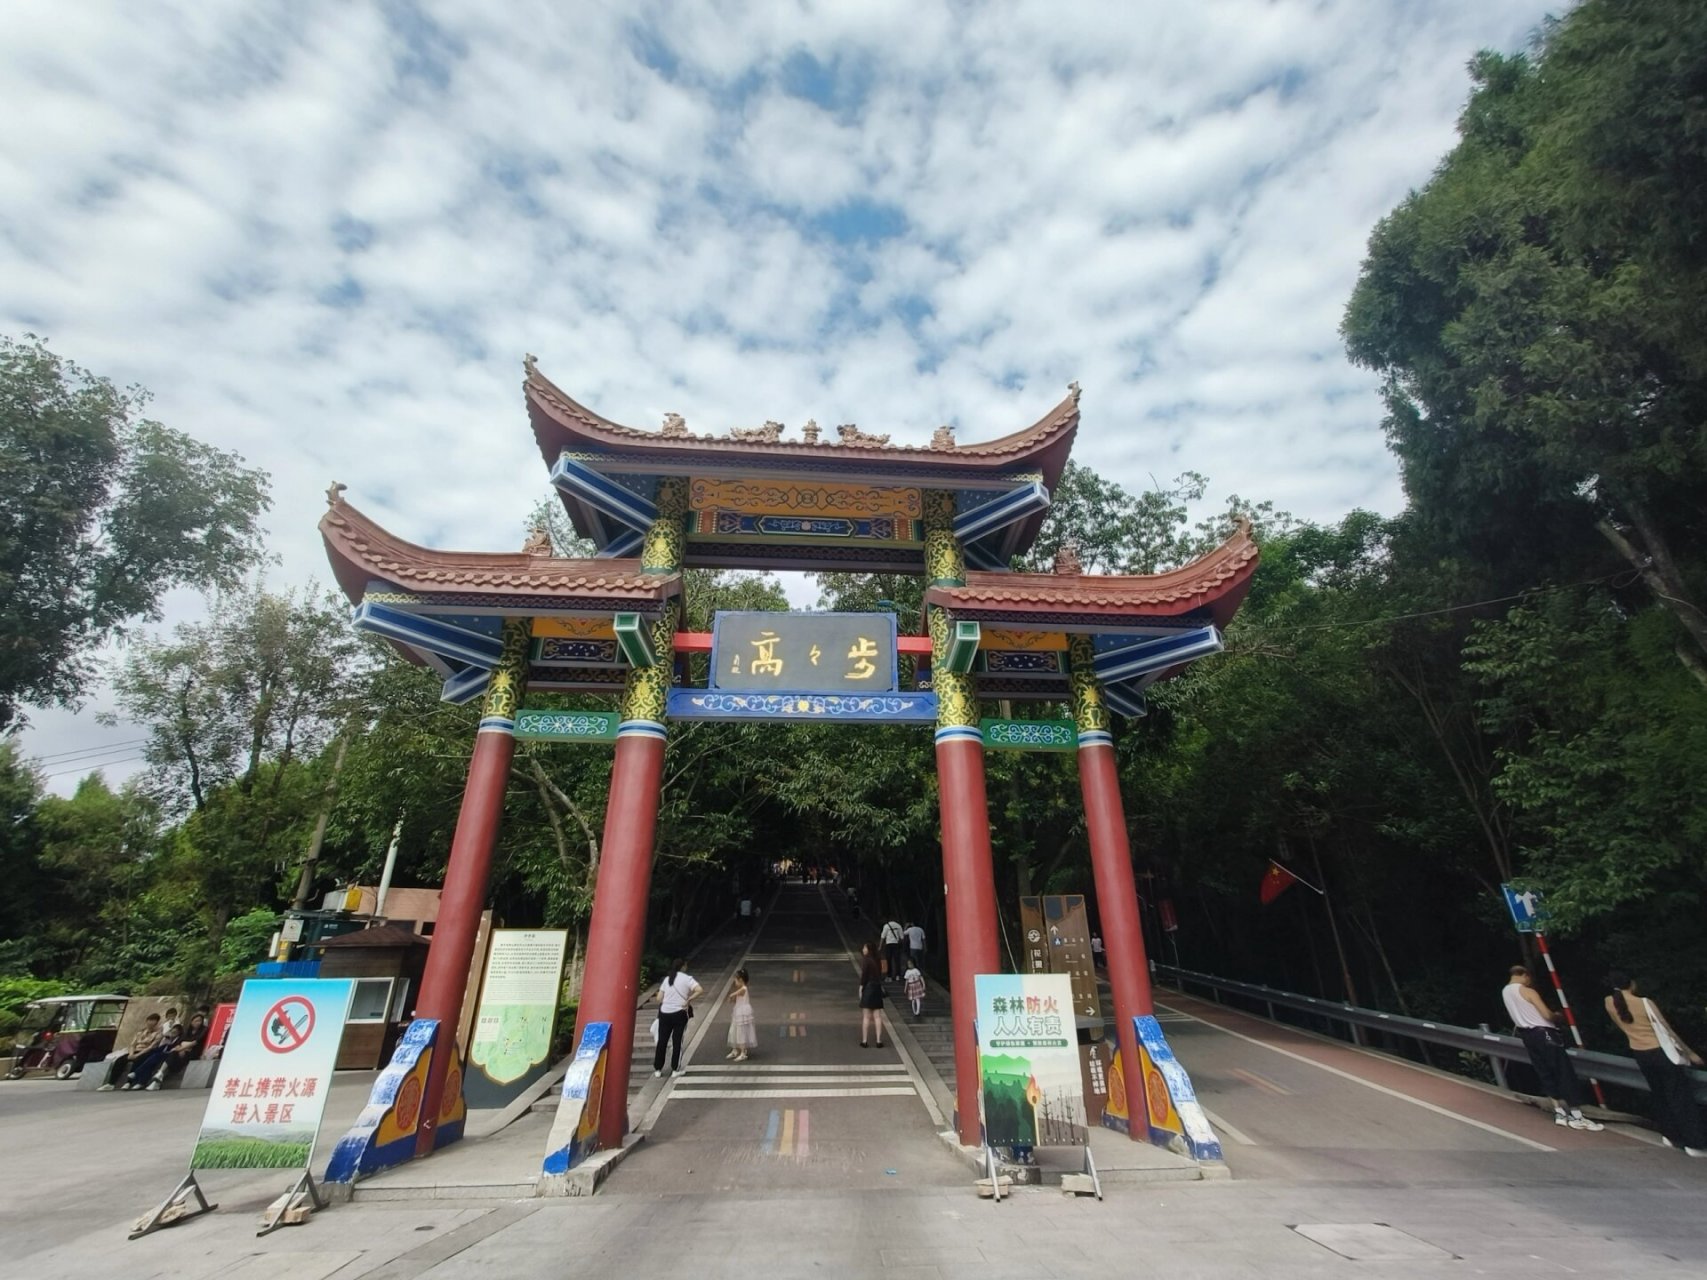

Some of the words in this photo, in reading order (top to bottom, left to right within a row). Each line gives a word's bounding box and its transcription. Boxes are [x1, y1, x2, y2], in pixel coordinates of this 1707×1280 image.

[993, 996, 1059, 1014] 森林防火
[993, 1015, 1062, 1036] 人人有责
[223, 1077, 318, 1098] 禁止携带火源
[230, 1103, 295, 1124] 进入景区
